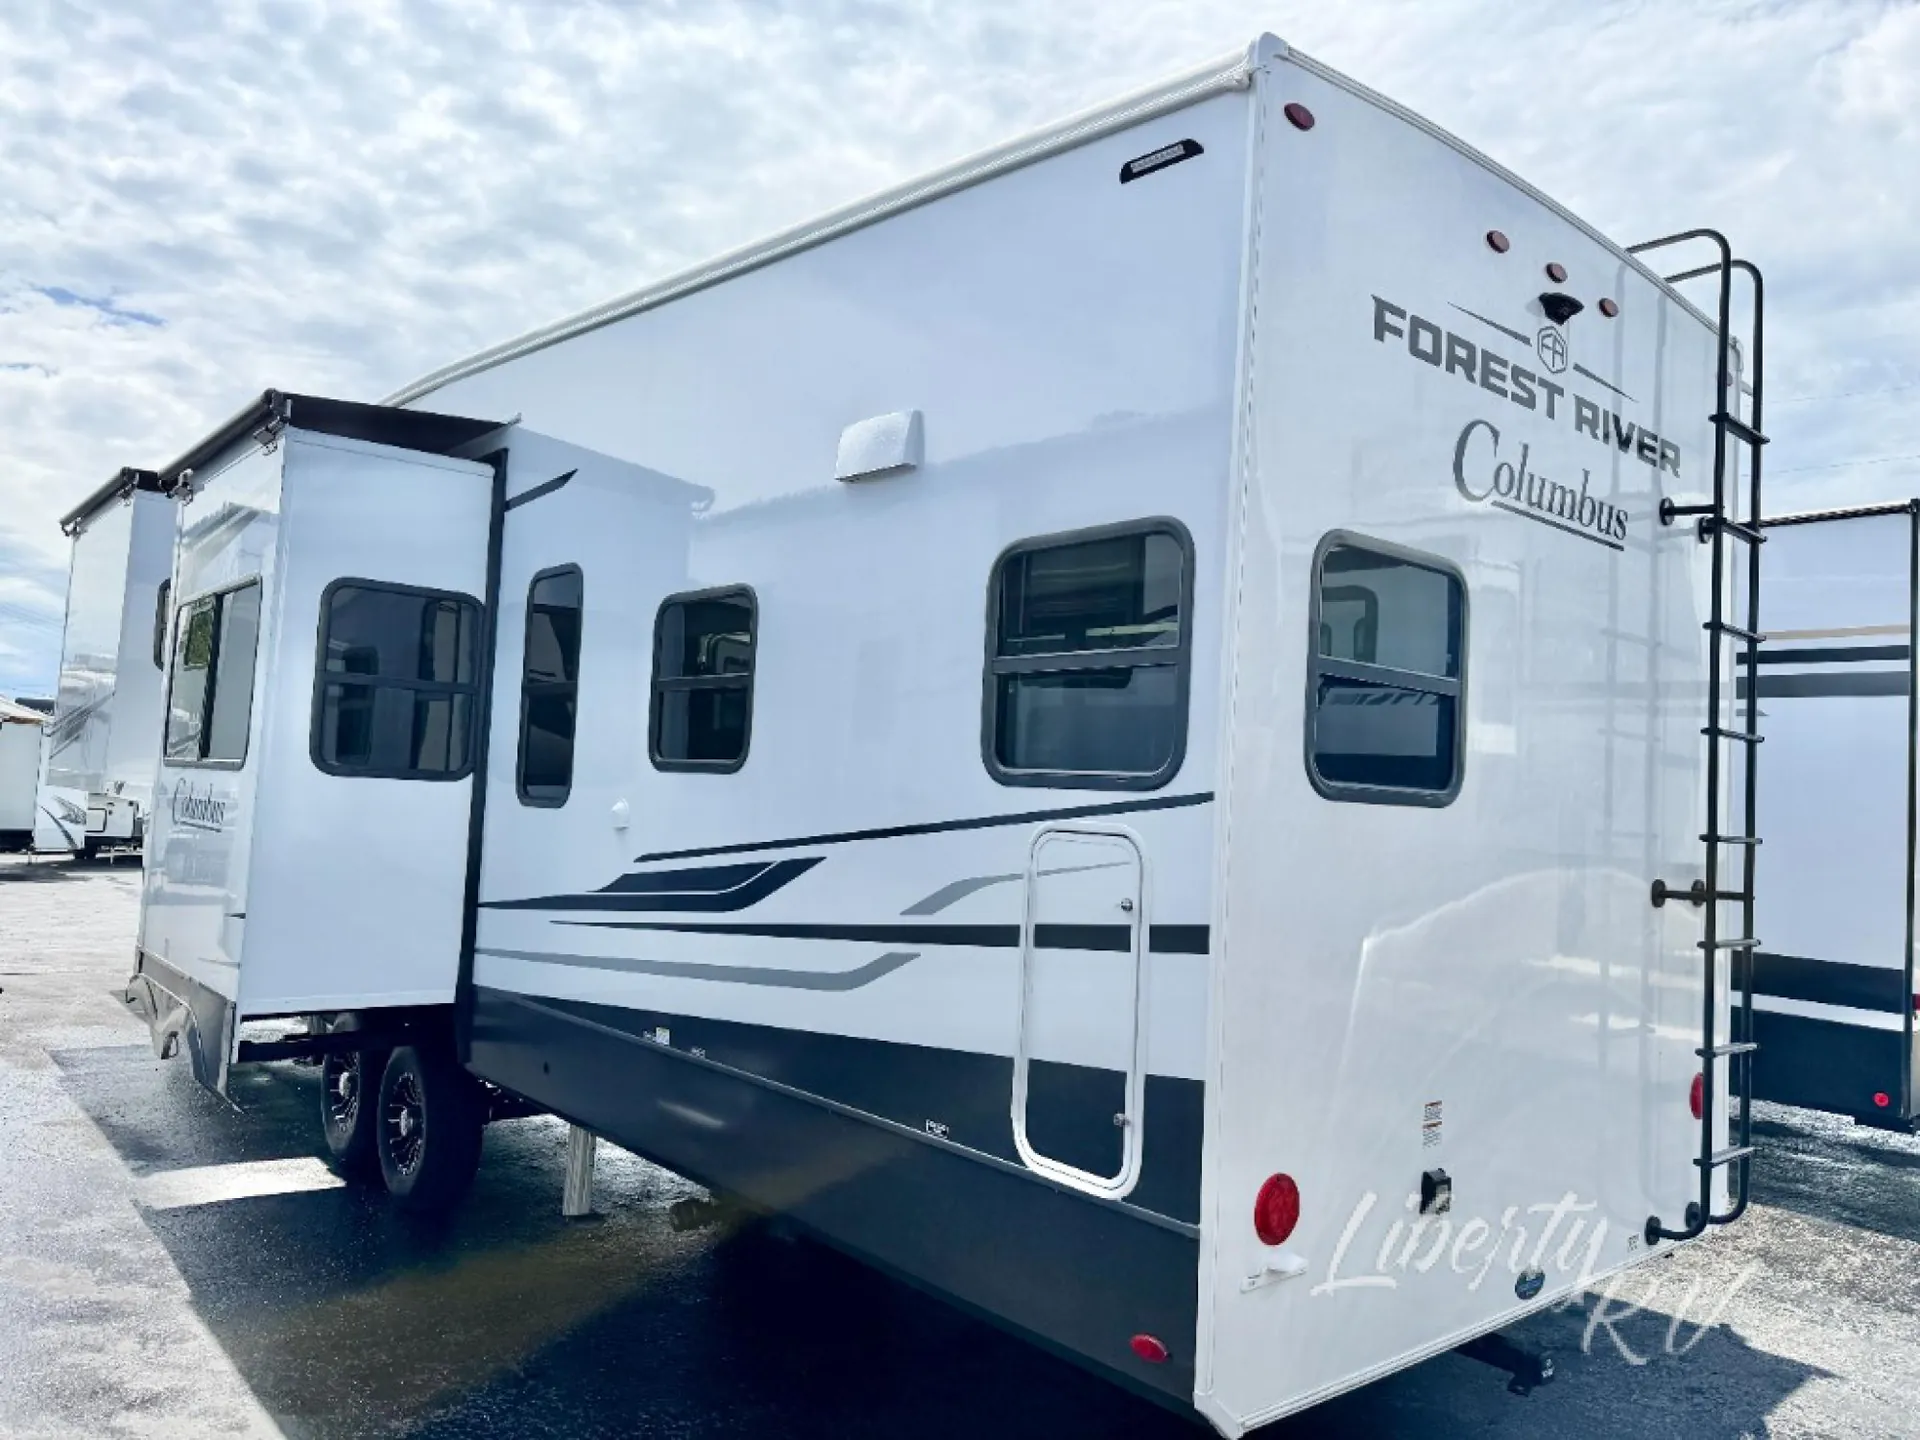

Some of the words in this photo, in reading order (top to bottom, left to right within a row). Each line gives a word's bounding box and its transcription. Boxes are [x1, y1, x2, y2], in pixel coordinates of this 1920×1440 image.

[1371, 294, 1565, 420] FOREST
[1573, 393, 1681, 478] RIVER
[1453, 418, 1629, 542] Columbus
